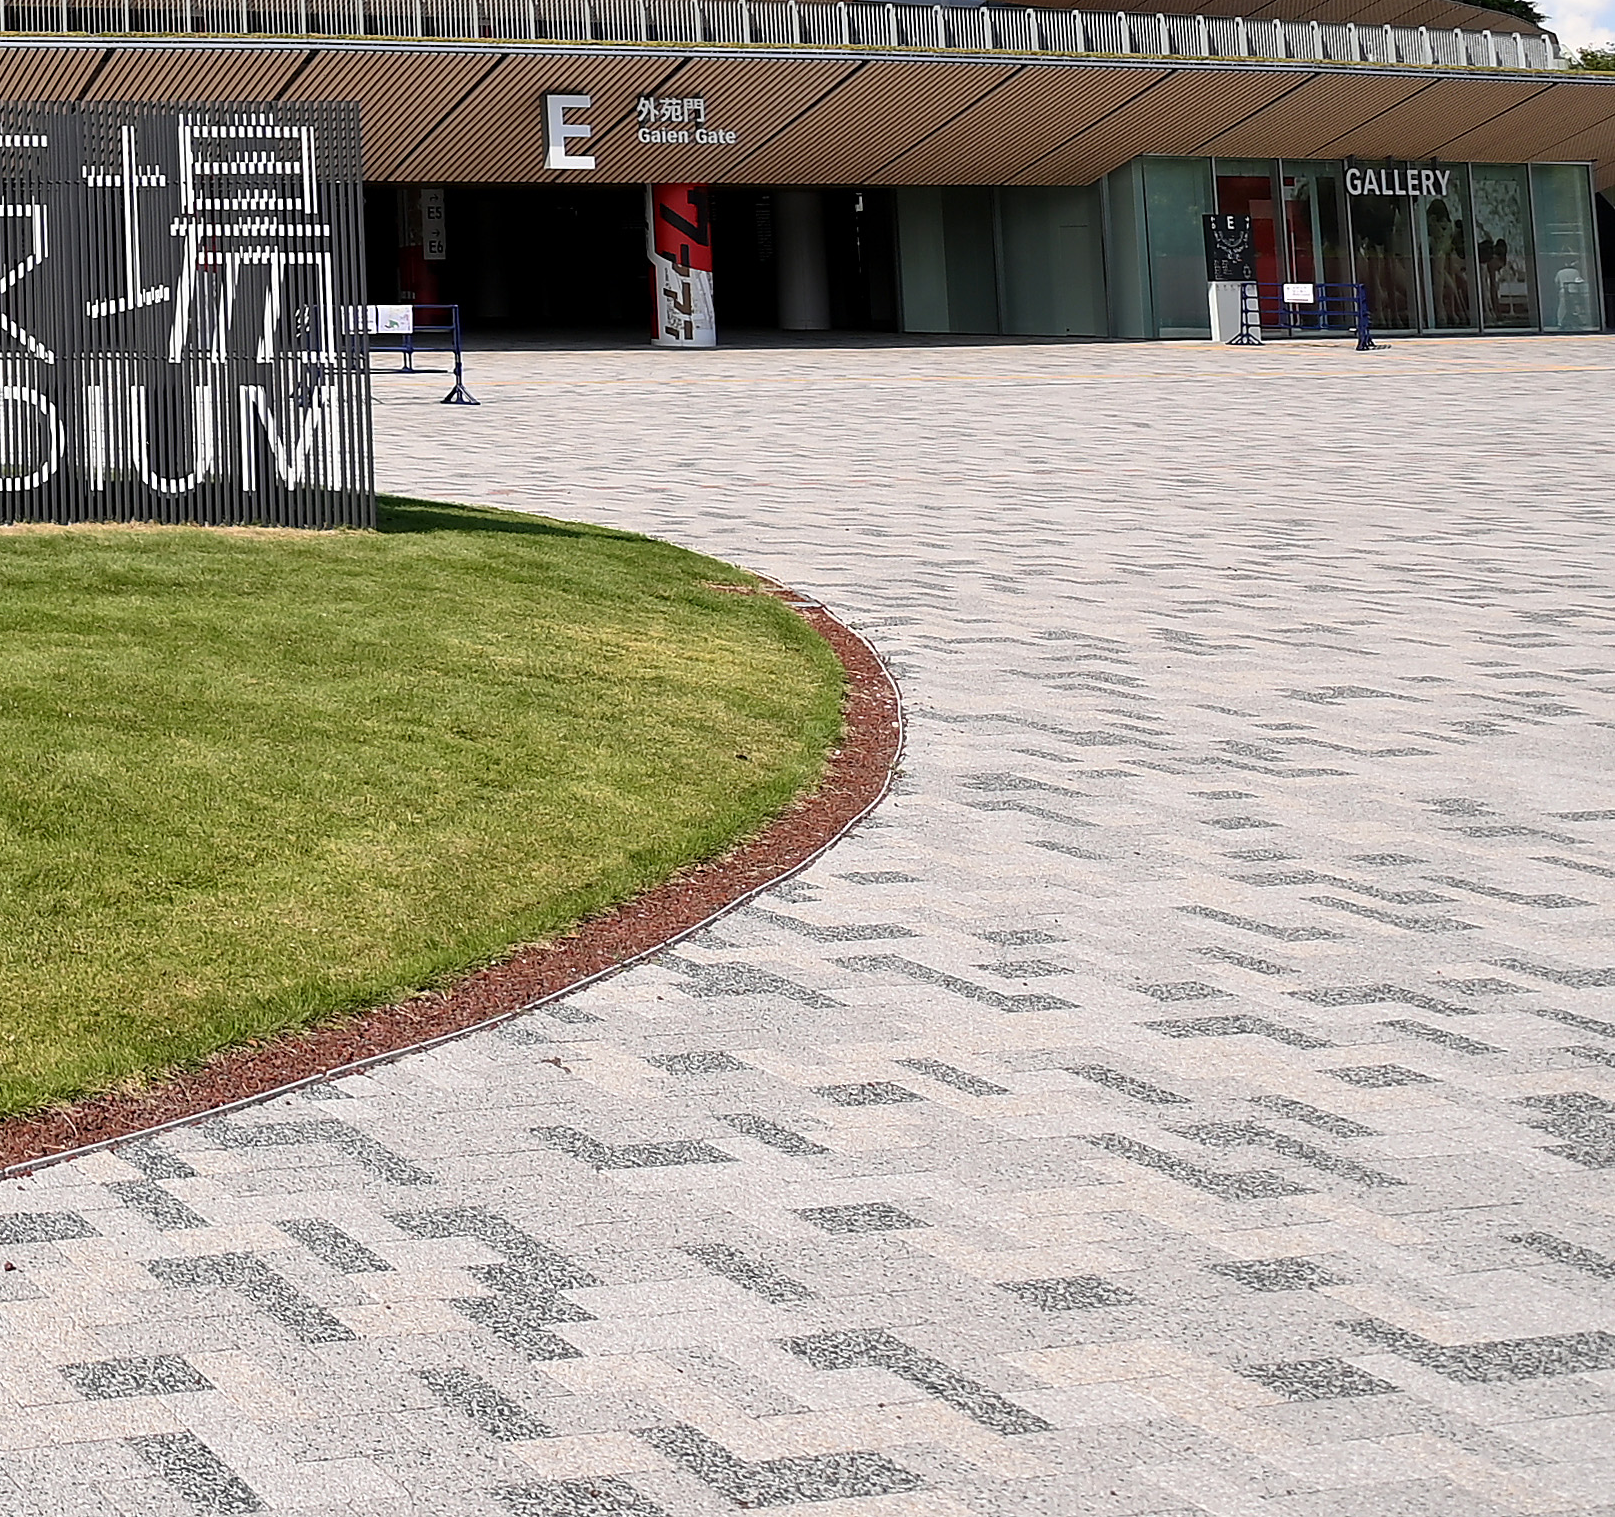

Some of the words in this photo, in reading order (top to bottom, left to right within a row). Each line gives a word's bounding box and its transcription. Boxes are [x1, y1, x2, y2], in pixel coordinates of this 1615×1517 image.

[636, 96, 706, 124] 外苑門
[545, 94, 596, 170] E
[637, 126, 690, 145] Gaien
[695, 128, 738, 145] Gate
[1345, 168, 1451, 196] GALLERY
[427, 206, 442, 220] E5
[429, 240, 444, 254] E6
